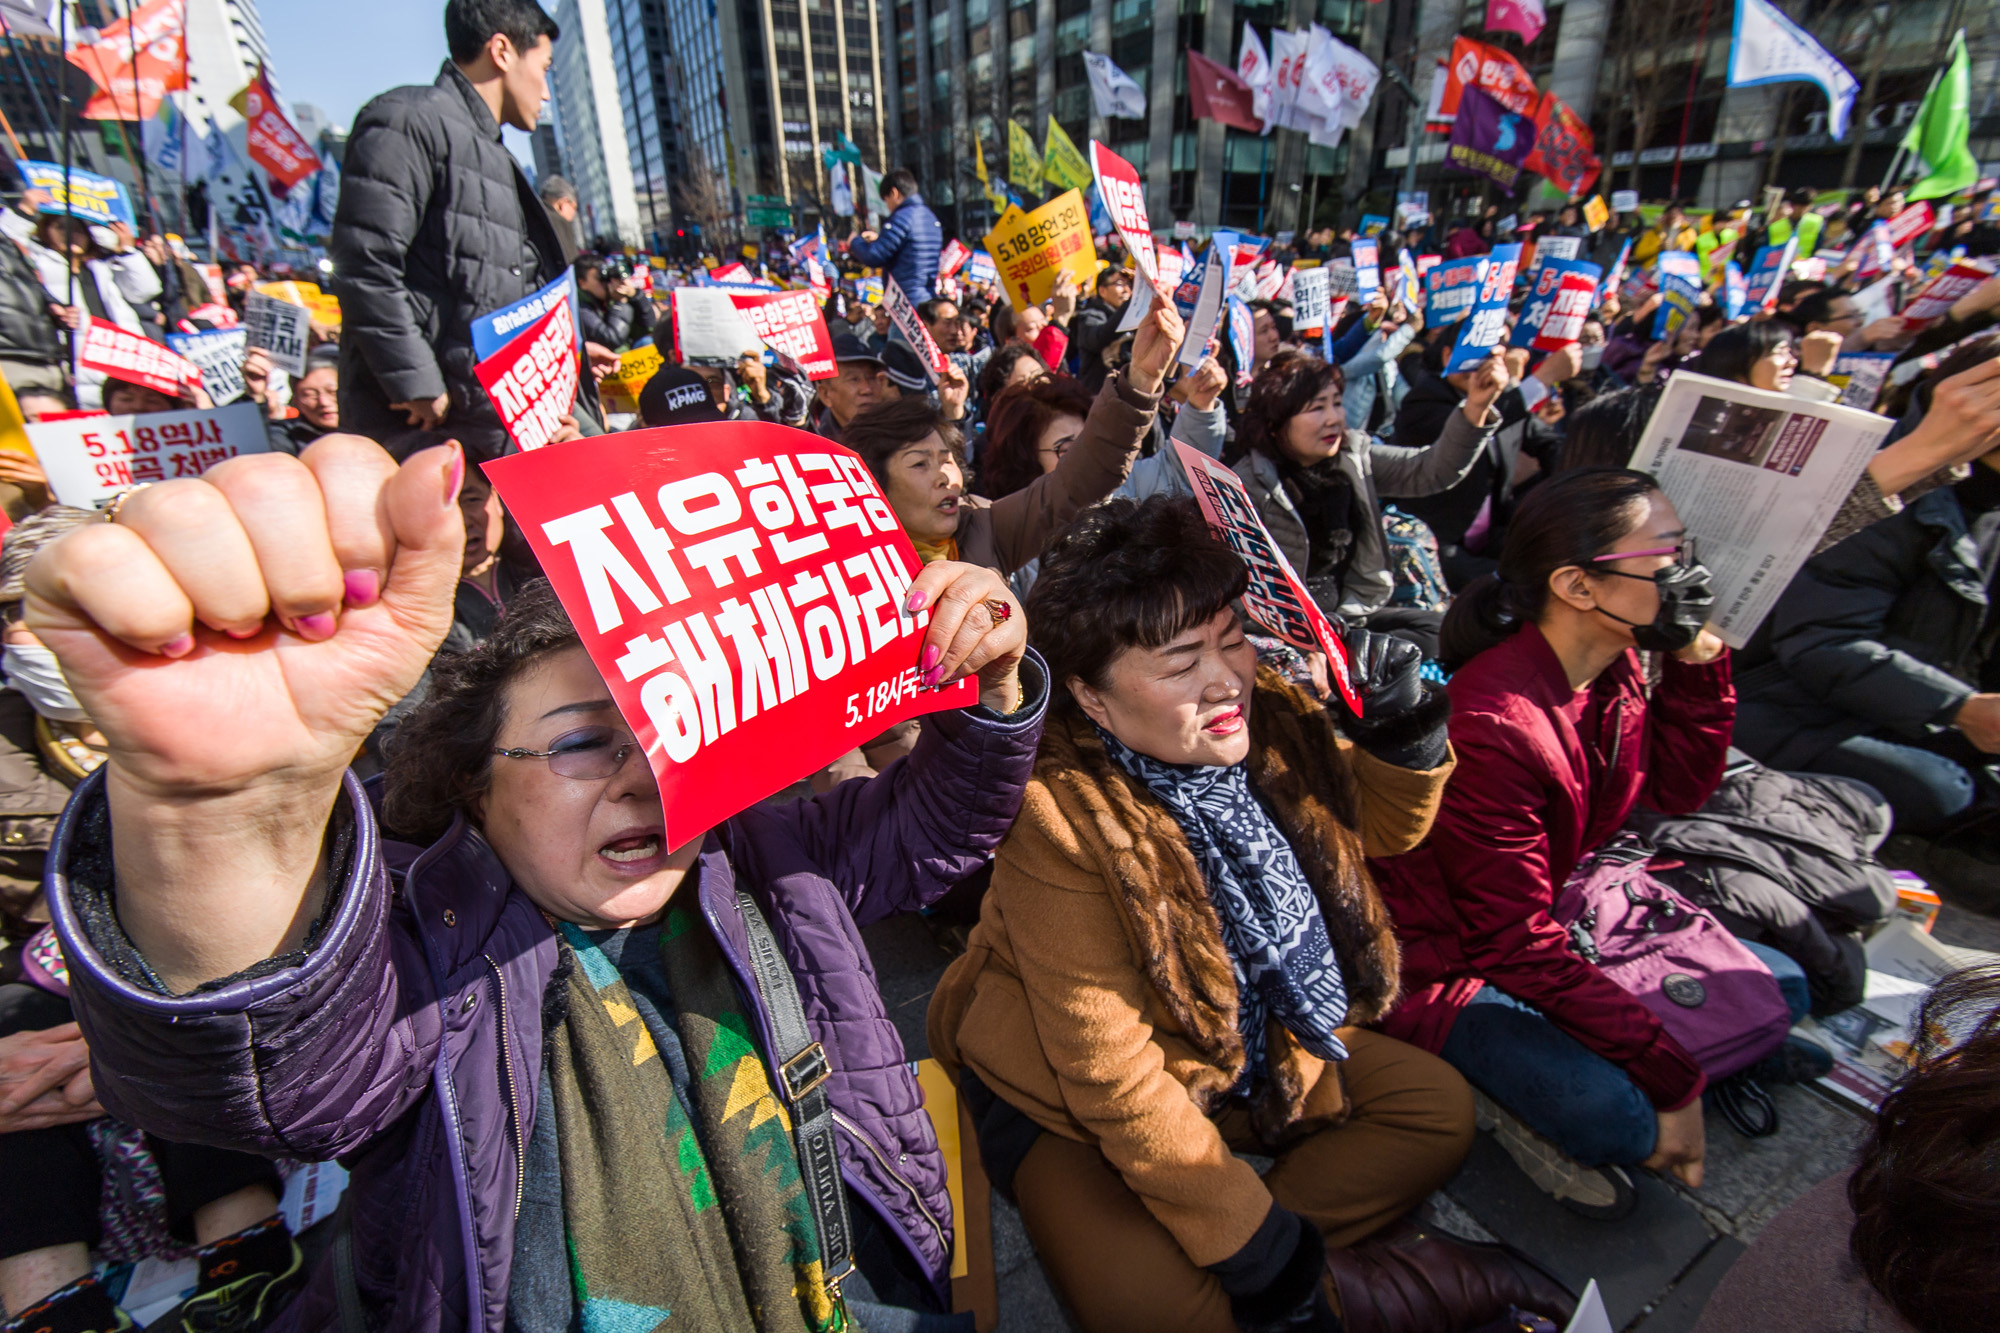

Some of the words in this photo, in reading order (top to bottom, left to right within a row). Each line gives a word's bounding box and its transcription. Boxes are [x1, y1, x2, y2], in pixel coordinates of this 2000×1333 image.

[997, 232, 1030, 262] 5.18
[1027, 215, 1060, 247] 망언
[1059, 204, 1080, 230] 3인
[1006, 243, 1063, 281] 국회의원
[489, 301, 574, 423] 자유한국당
[667, 390, 707, 412] KPMG
[80, 418, 223, 458] 5.18역사
[94, 458, 164, 487] 왜곡
[540, 453, 898, 635] 자유한국당
[615, 543, 930, 764] 해체하라!
[845, 666, 966, 728] 5.18시국
[758, 935, 784, 990] LOUIS
